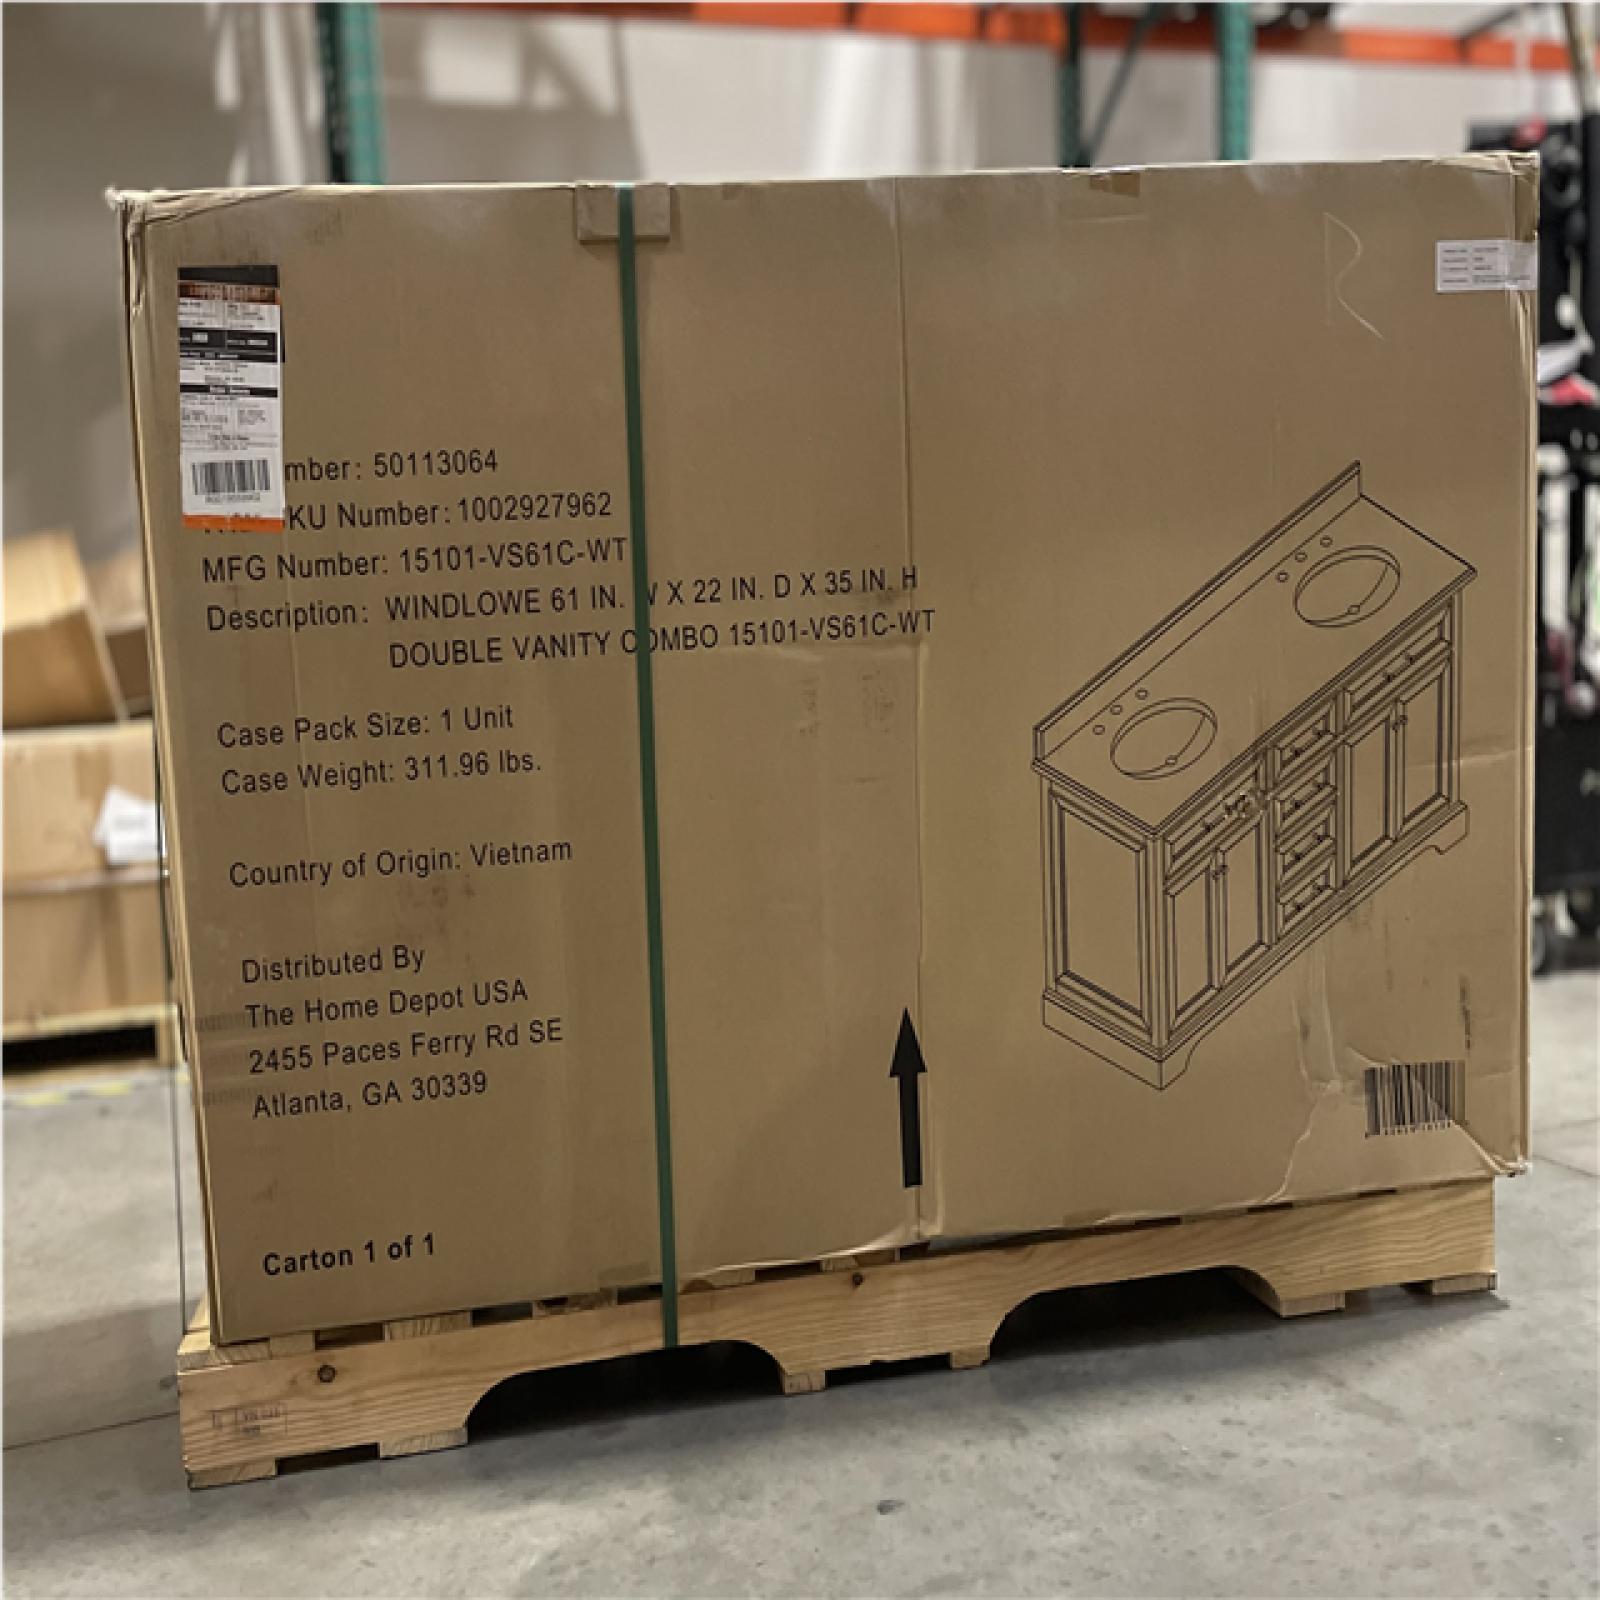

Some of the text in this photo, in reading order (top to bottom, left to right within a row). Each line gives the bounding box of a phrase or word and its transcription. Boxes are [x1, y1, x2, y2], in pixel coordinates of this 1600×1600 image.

[285, 448, 498, 482] mber: 50113064
[289, 504, 326, 530] KU
[338, 500, 451, 529] Number:
[458, 492, 611, 522] 1002927962
[203, 537, 626, 582] MFG Number: 15101-VS61C-WT
[207, 603, 369, 632] Description:
[385, 588, 540, 621] WINDLOWE
[551, 588, 578, 612] 61
[590, 586, 625, 609] IN.
[668, 580, 683, 603] X
[695, 579, 721, 603] 22
[732, 577, 763, 600] IN.
[775, 574, 790, 597] D
[800, 572, 816, 595] X
[824, 570, 851, 594] 35
[862, 568, 893, 592] IN.
[903, 566, 917, 589] H
[390, 637, 502, 668] DOUBLE
[513, 631, 611, 661] VANITY
[730, 609, 935, 646] 15101-VS61C-WT
[218, 704, 513, 748] Case Pack Size: 1 Unit
[222, 750, 540, 795] Case Weight: 311.96 lbs.
[230, 841, 571, 888] Country of Origin: Vietnam
[242, 944, 424, 983] Distributed By
[245, 978, 527, 1028] The Home Depot USA
[249, 1018, 563, 1074] 2455 Paces Ferry Rd SE
[252, 1070, 487, 1119] Atlanta, GA 30339
[264, 1232, 433, 1275] Carton 1 of 1
